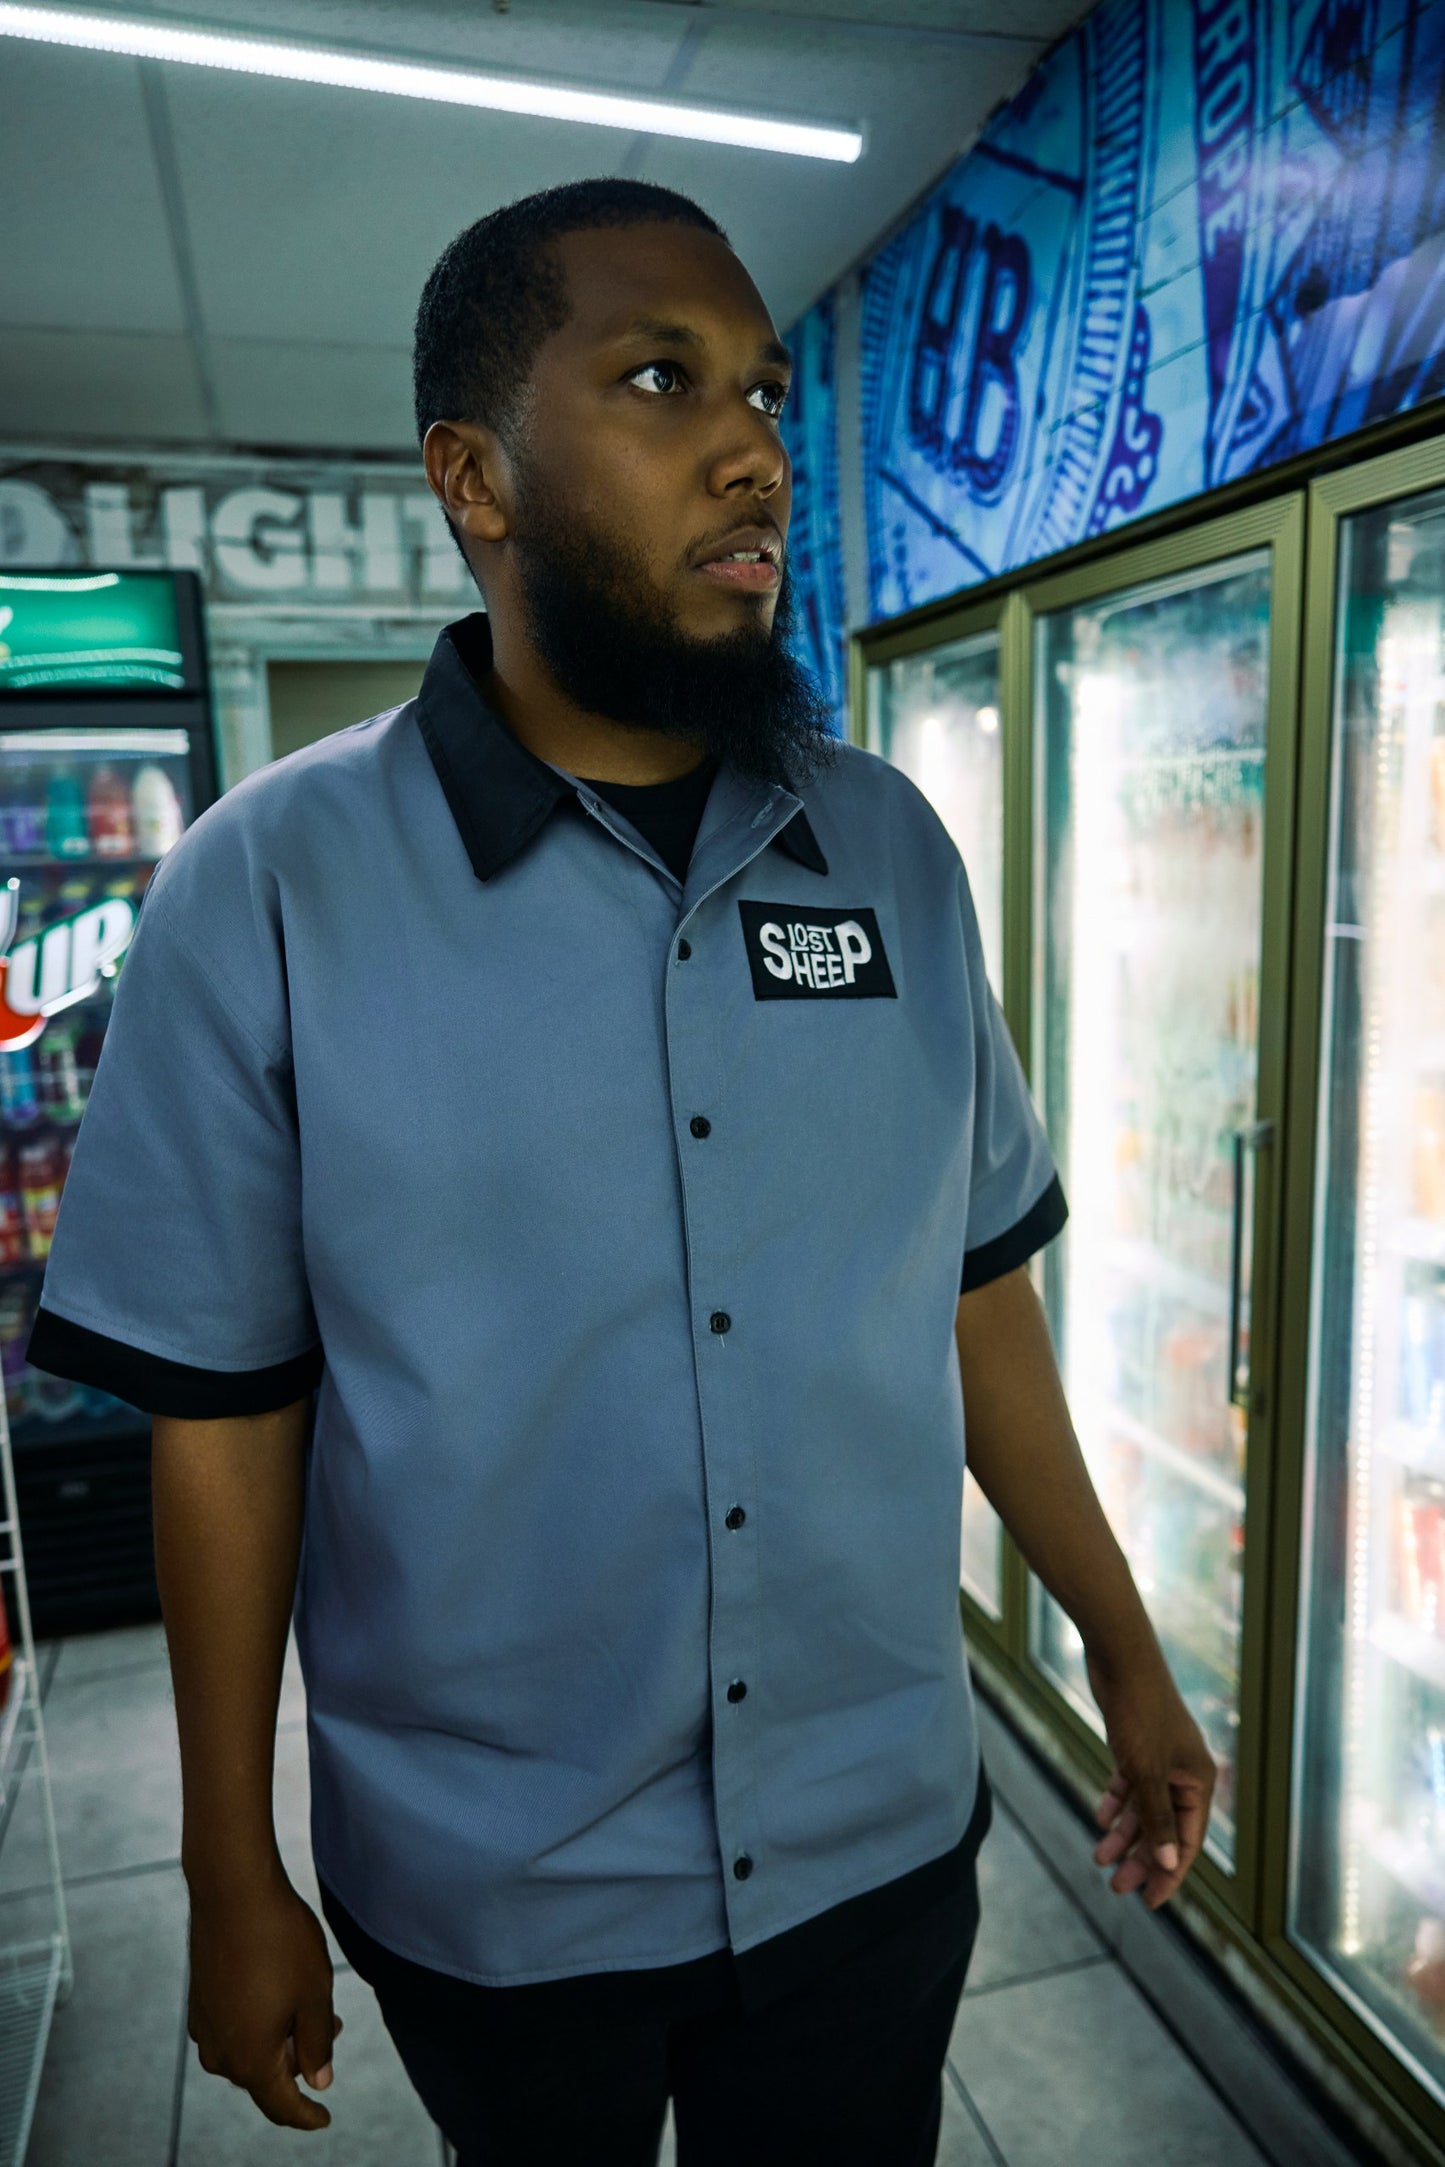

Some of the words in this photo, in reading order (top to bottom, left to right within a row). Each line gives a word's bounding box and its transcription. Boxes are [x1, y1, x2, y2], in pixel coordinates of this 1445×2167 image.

[1197, 0, 1250, 259] ROPE
[85, 481, 473, 590] LIGHT
[787, 923, 833, 953] LOST
